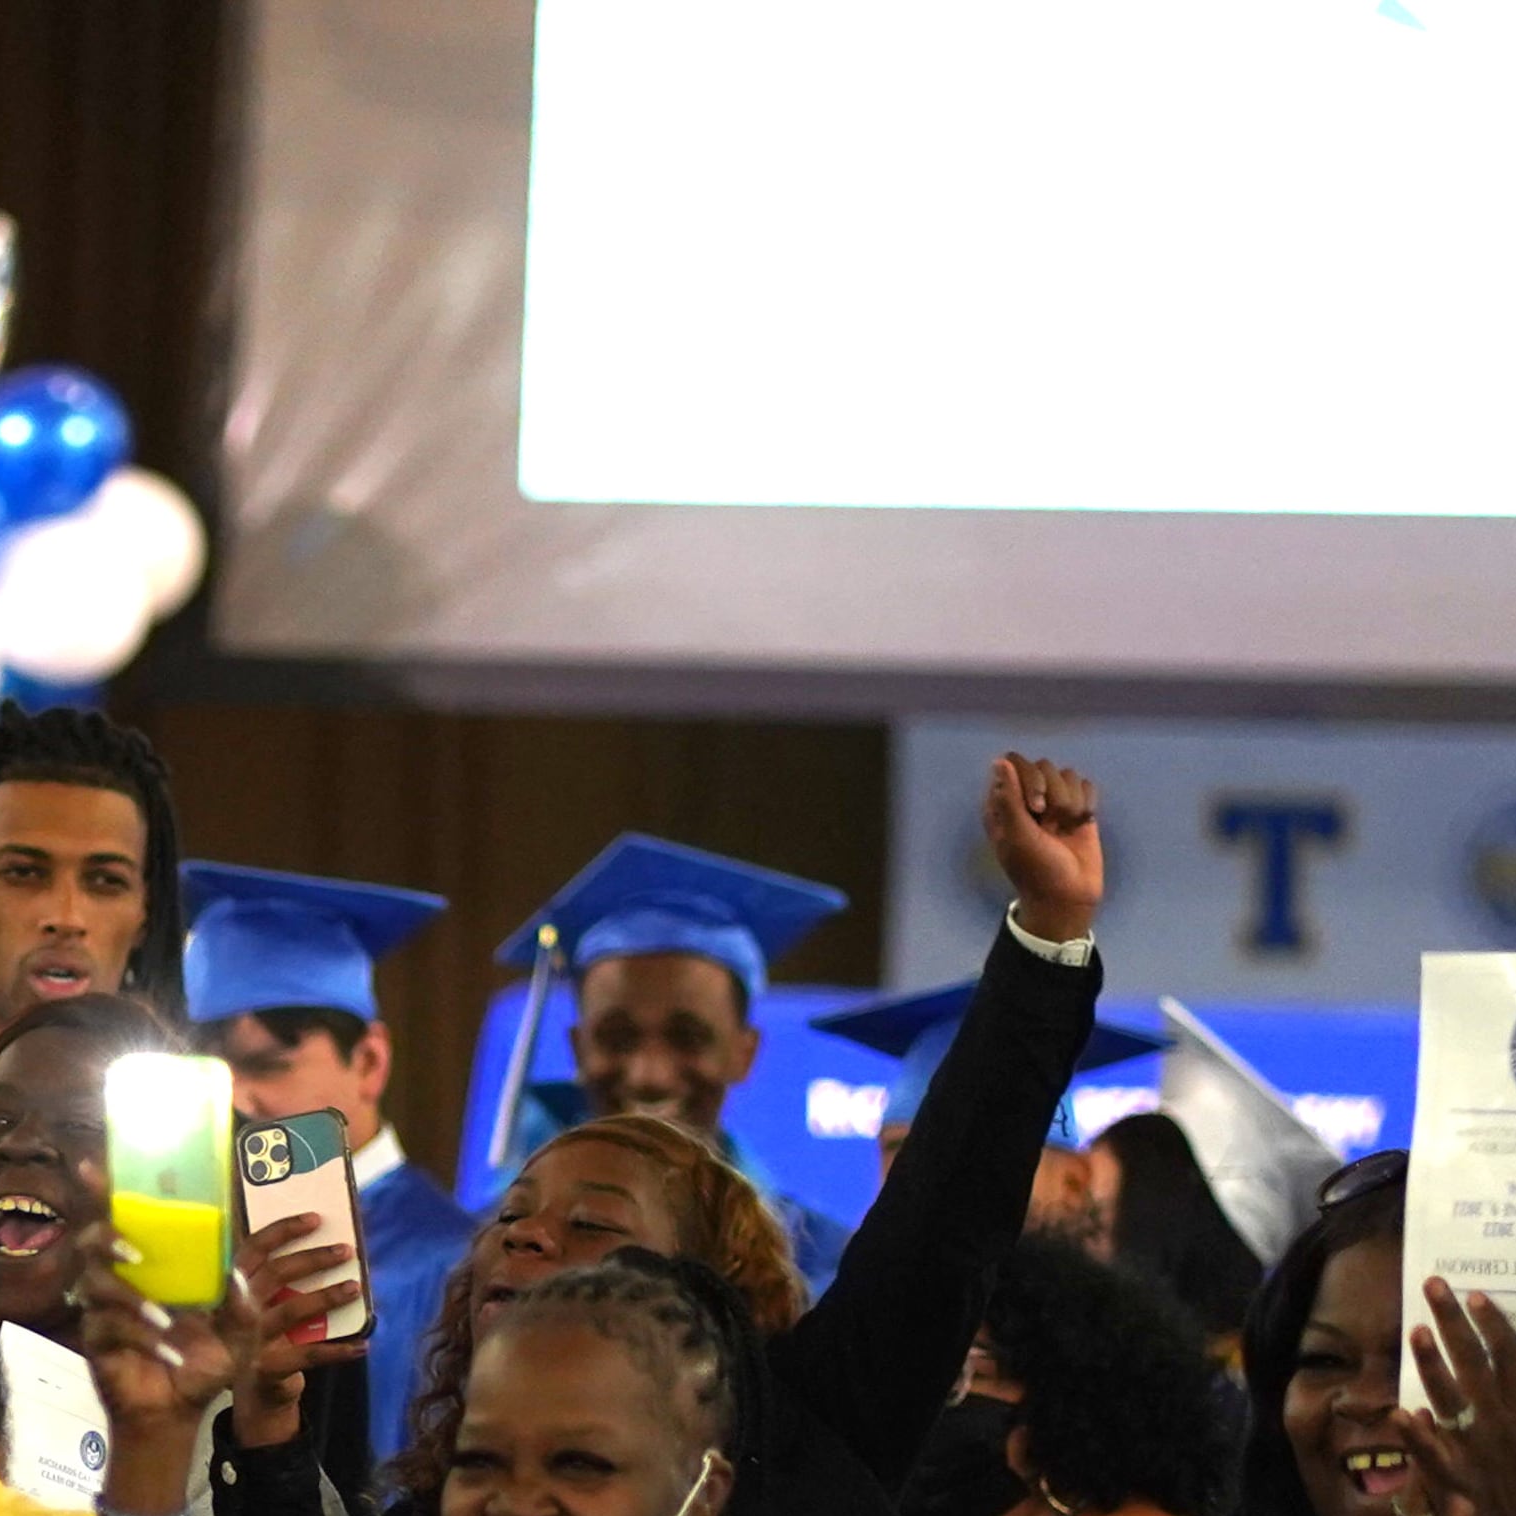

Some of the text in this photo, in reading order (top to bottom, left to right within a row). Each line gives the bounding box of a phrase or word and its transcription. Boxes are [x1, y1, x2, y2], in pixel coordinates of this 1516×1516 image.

[1213, 799, 1348, 950] T
[1434, 1257, 1509, 1278] CEREMONY
[40, 1469, 65, 1486] CLASS
